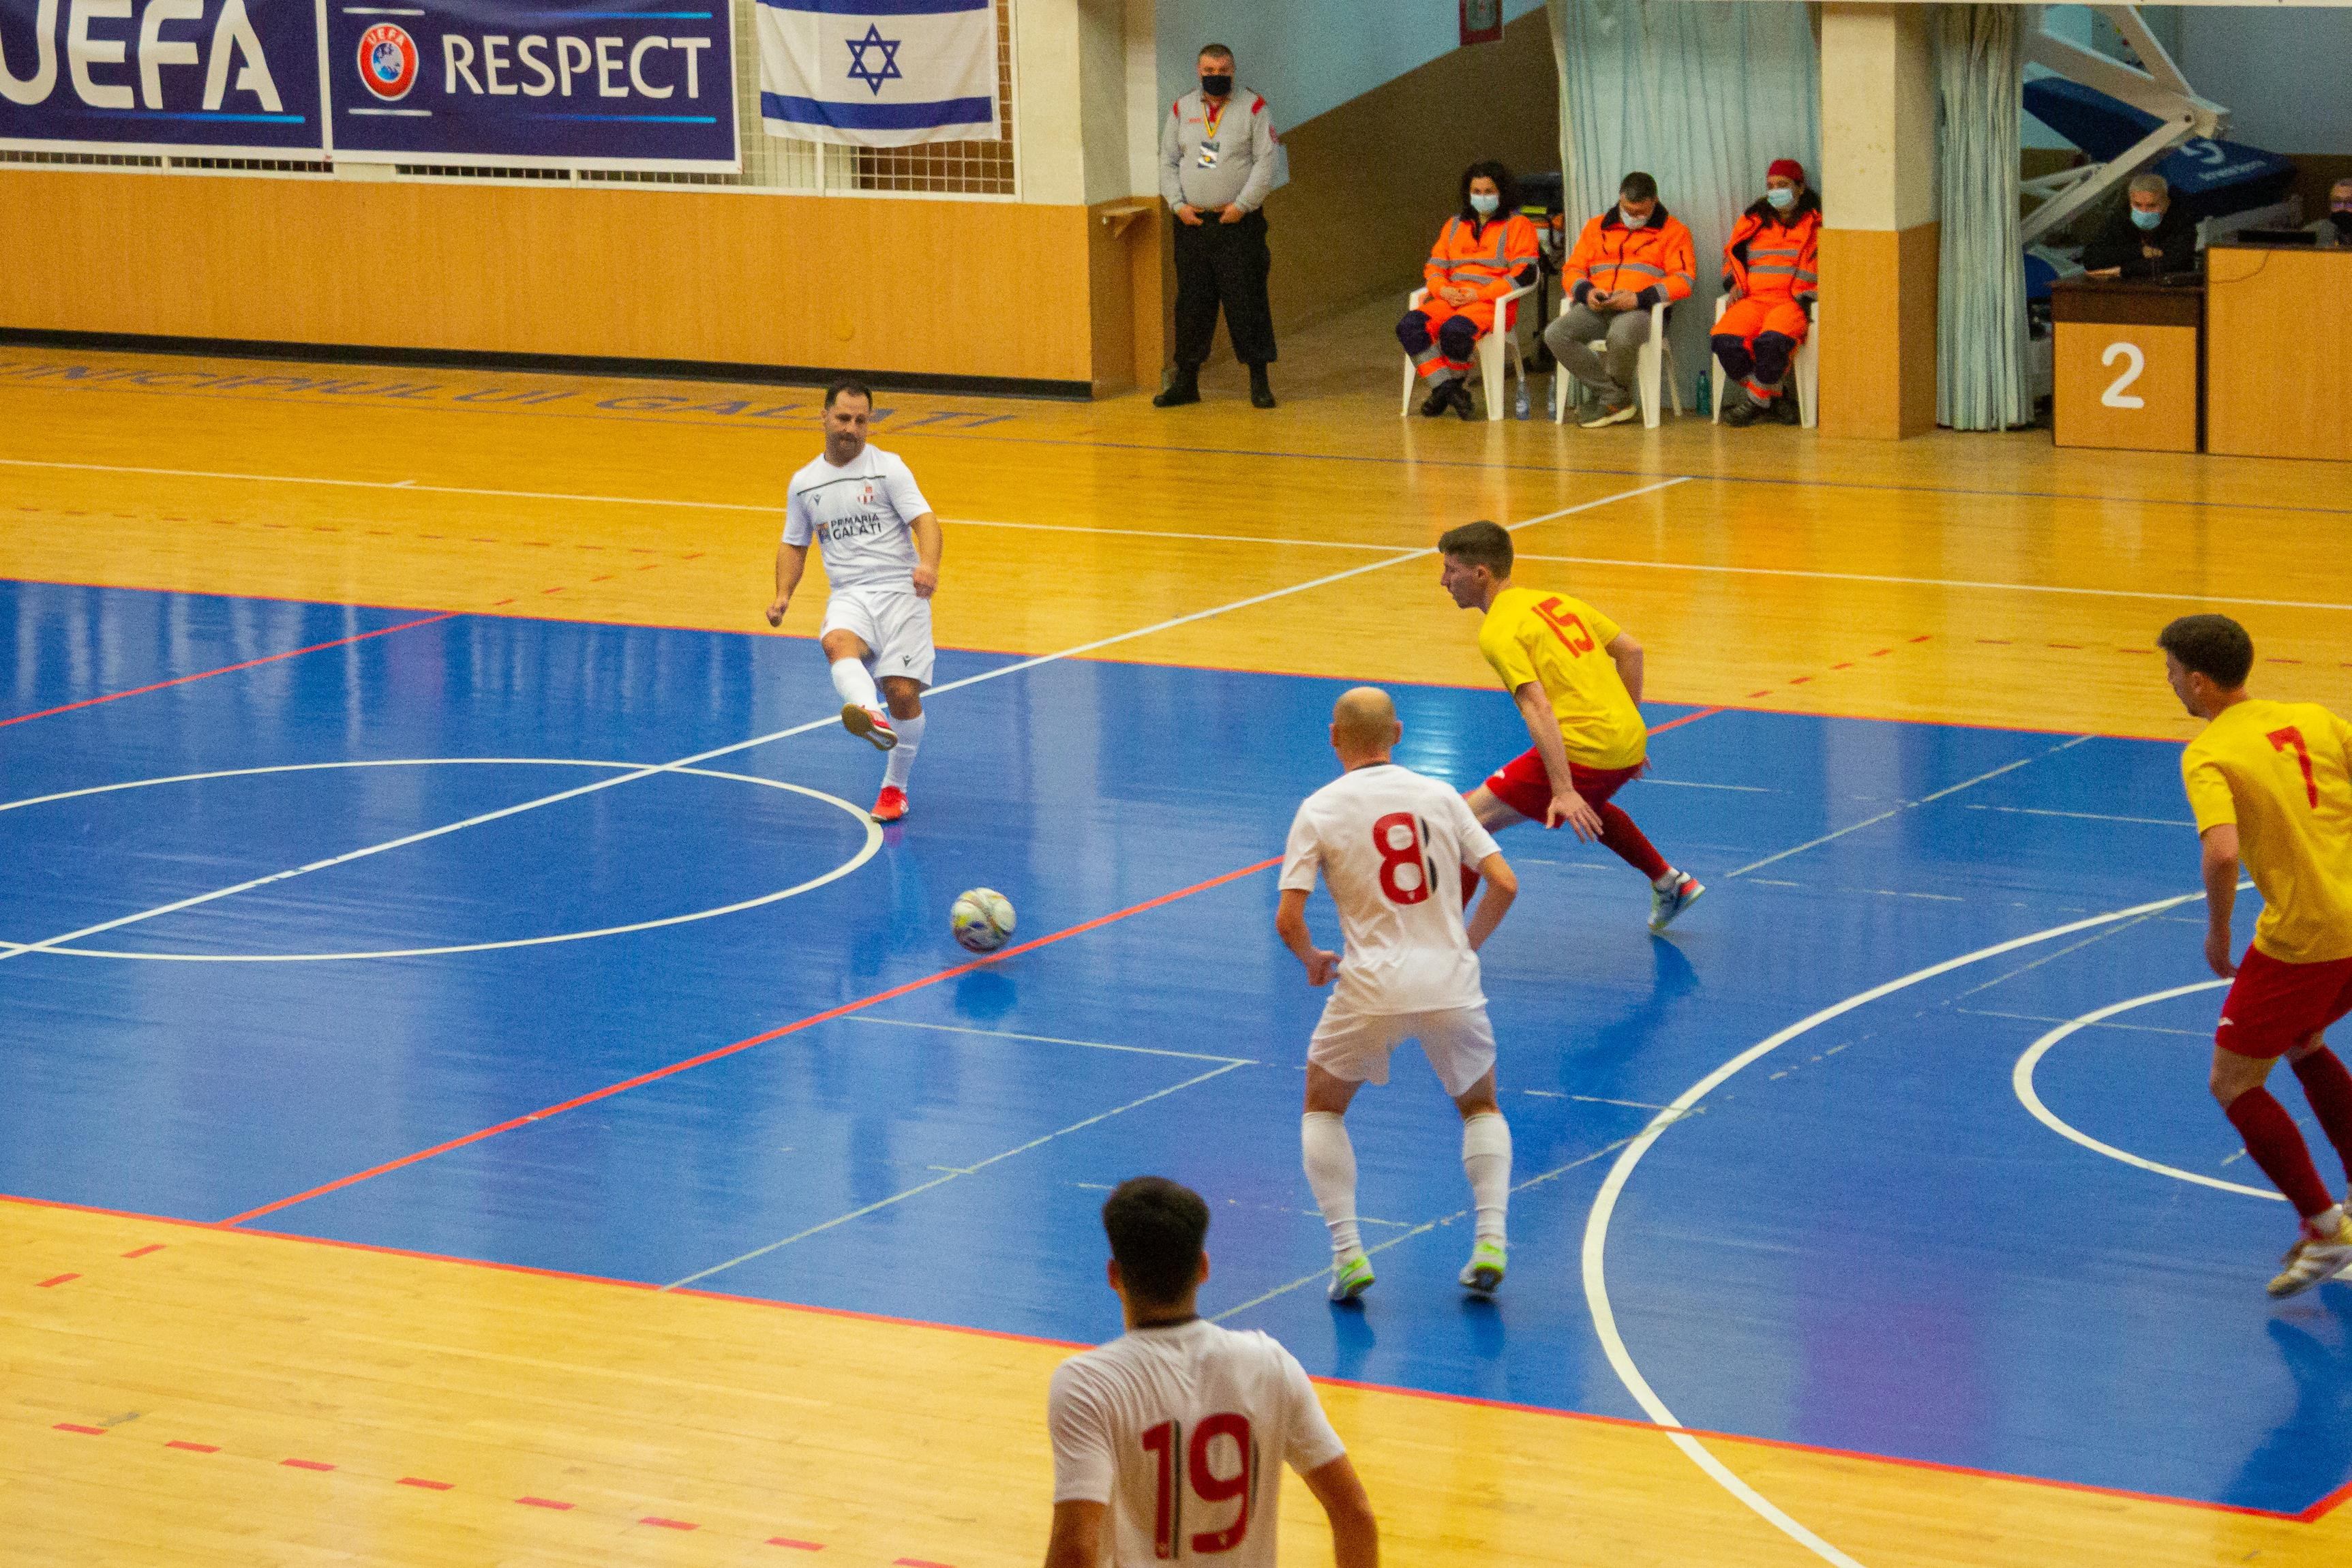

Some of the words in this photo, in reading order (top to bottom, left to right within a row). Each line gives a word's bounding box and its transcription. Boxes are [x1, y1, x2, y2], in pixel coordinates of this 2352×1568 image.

[0, 0, 283, 112] UEFA
[367, 27, 404, 46] UEFA
[442, 34, 711, 99] RESPECT
[2101, 342, 2145, 408] 2
[833, 522, 881, 540] GALATI
[1531, 597, 1595, 659] 15
[2265, 725, 2318, 809] 7
[1372, 811, 1430, 905] 8
[1141, 1412, 1252, 1560] 19
